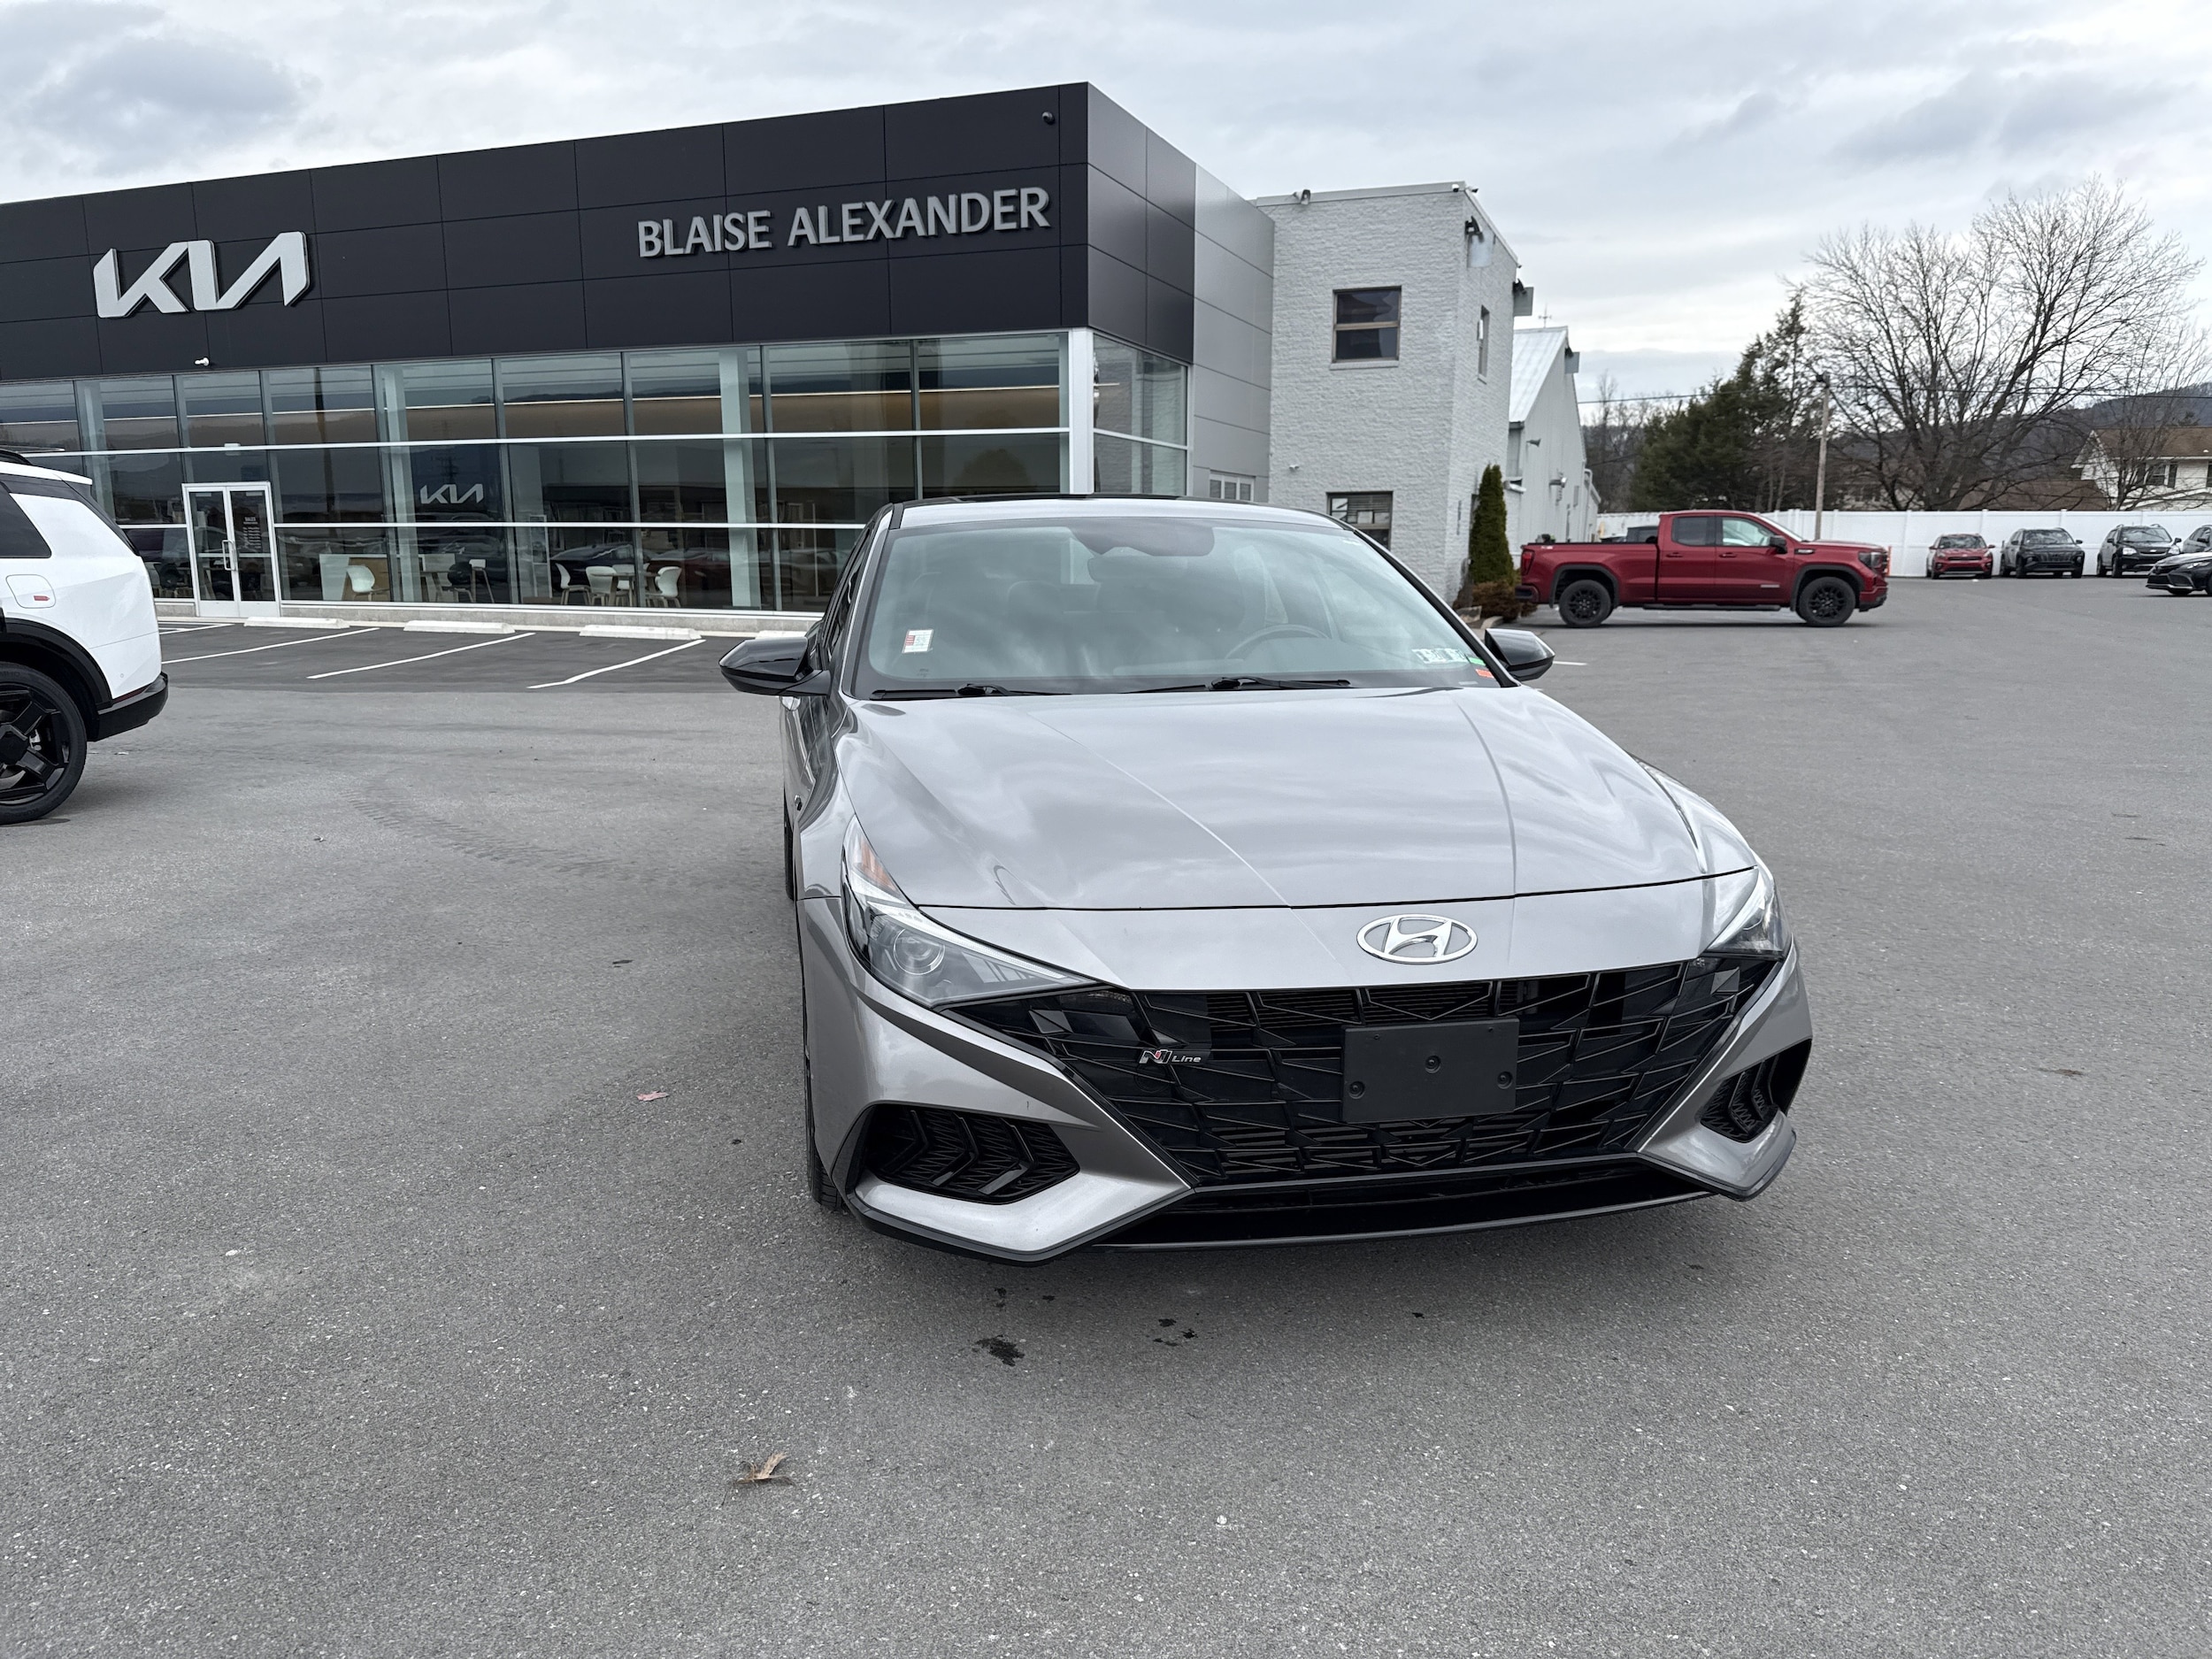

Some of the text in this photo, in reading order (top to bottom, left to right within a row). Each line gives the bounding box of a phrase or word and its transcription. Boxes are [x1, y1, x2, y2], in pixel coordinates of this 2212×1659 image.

[638, 187, 1050, 258] BLAISE ALEXANDER
[93, 231, 309, 319] KIA
[419, 483, 484, 504] KIA
